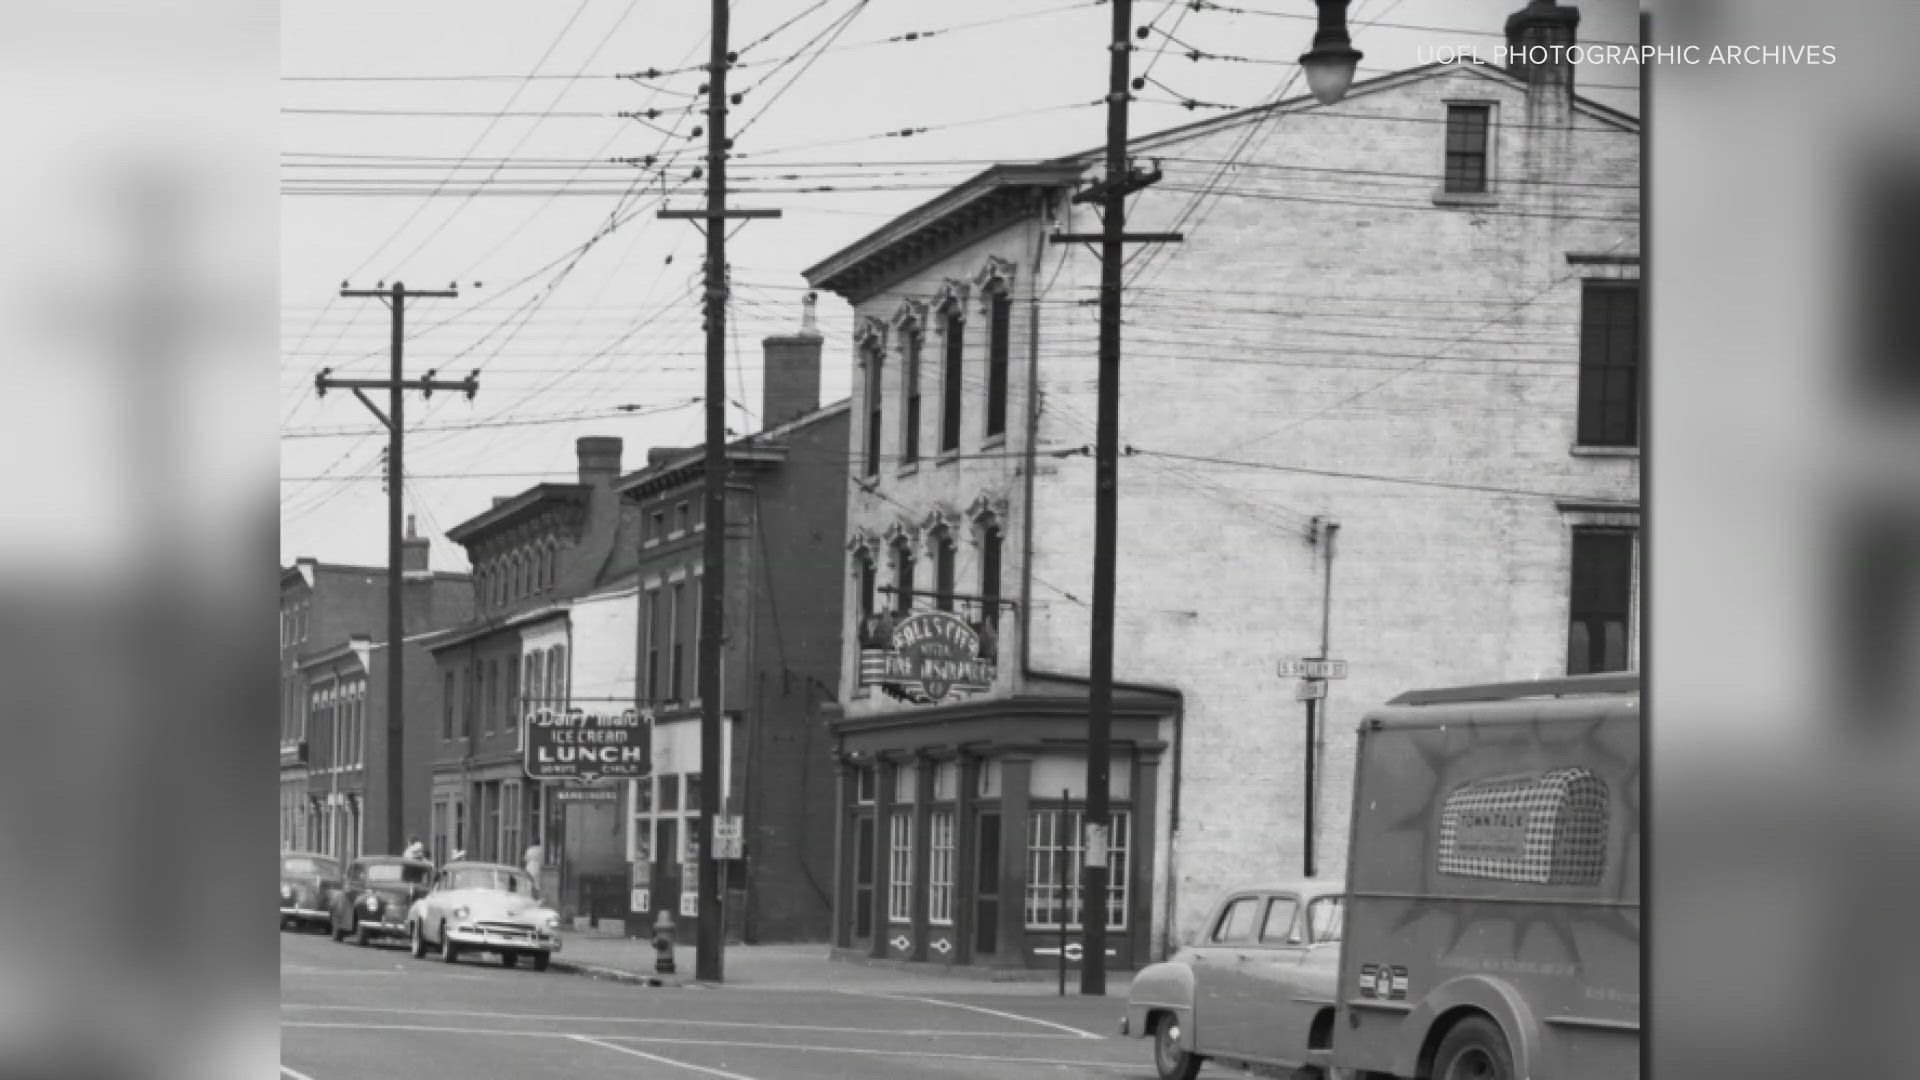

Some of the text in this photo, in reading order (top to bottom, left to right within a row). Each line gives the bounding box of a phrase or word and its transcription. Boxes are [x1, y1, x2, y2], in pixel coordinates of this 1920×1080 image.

[552, 730, 628, 744] ICE CREAM
[537, 745, 641, 763] LUNCH
